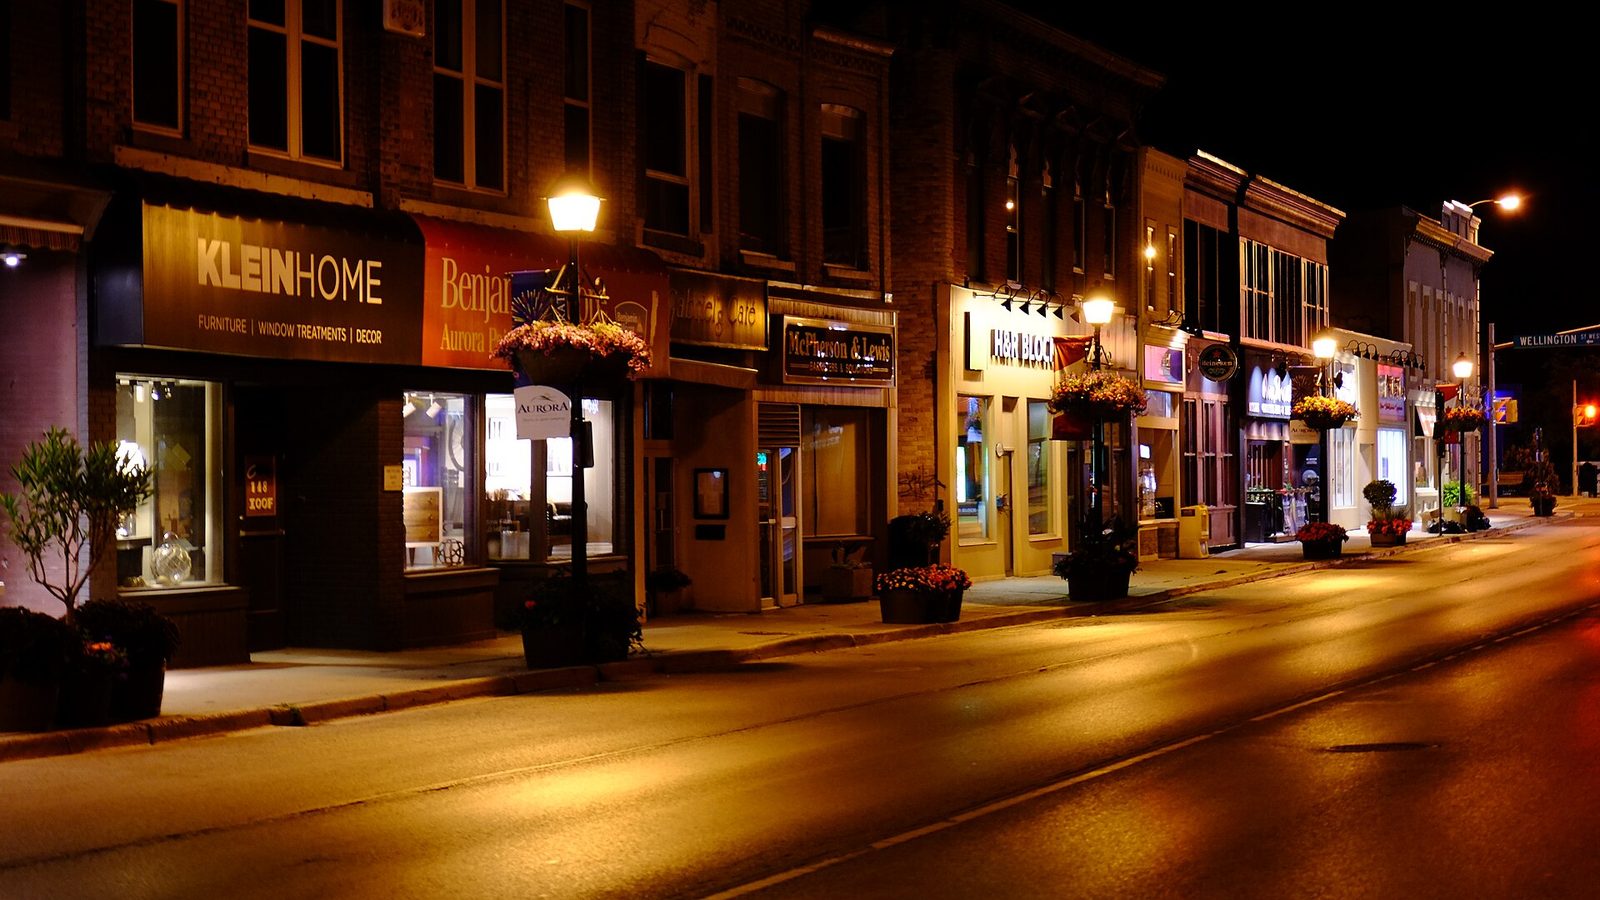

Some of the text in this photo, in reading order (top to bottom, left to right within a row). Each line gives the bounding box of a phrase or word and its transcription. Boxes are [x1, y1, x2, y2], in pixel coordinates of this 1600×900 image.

[198, 313, 382, 344] FURNITURE WINDOW TREATMENTS DECOR
[440, 322, 485, 353] Aurora
[789, 331, 891, 363] McPherson & Lewis
[991, 329, 1019, 360] H&R
[1519, 334, 1577, 347] WELLINGTON
[517, 401, 569, 414] AURORA
[250, 480, 268, 494] 148
[248, 497, 273, 510] IOOF
